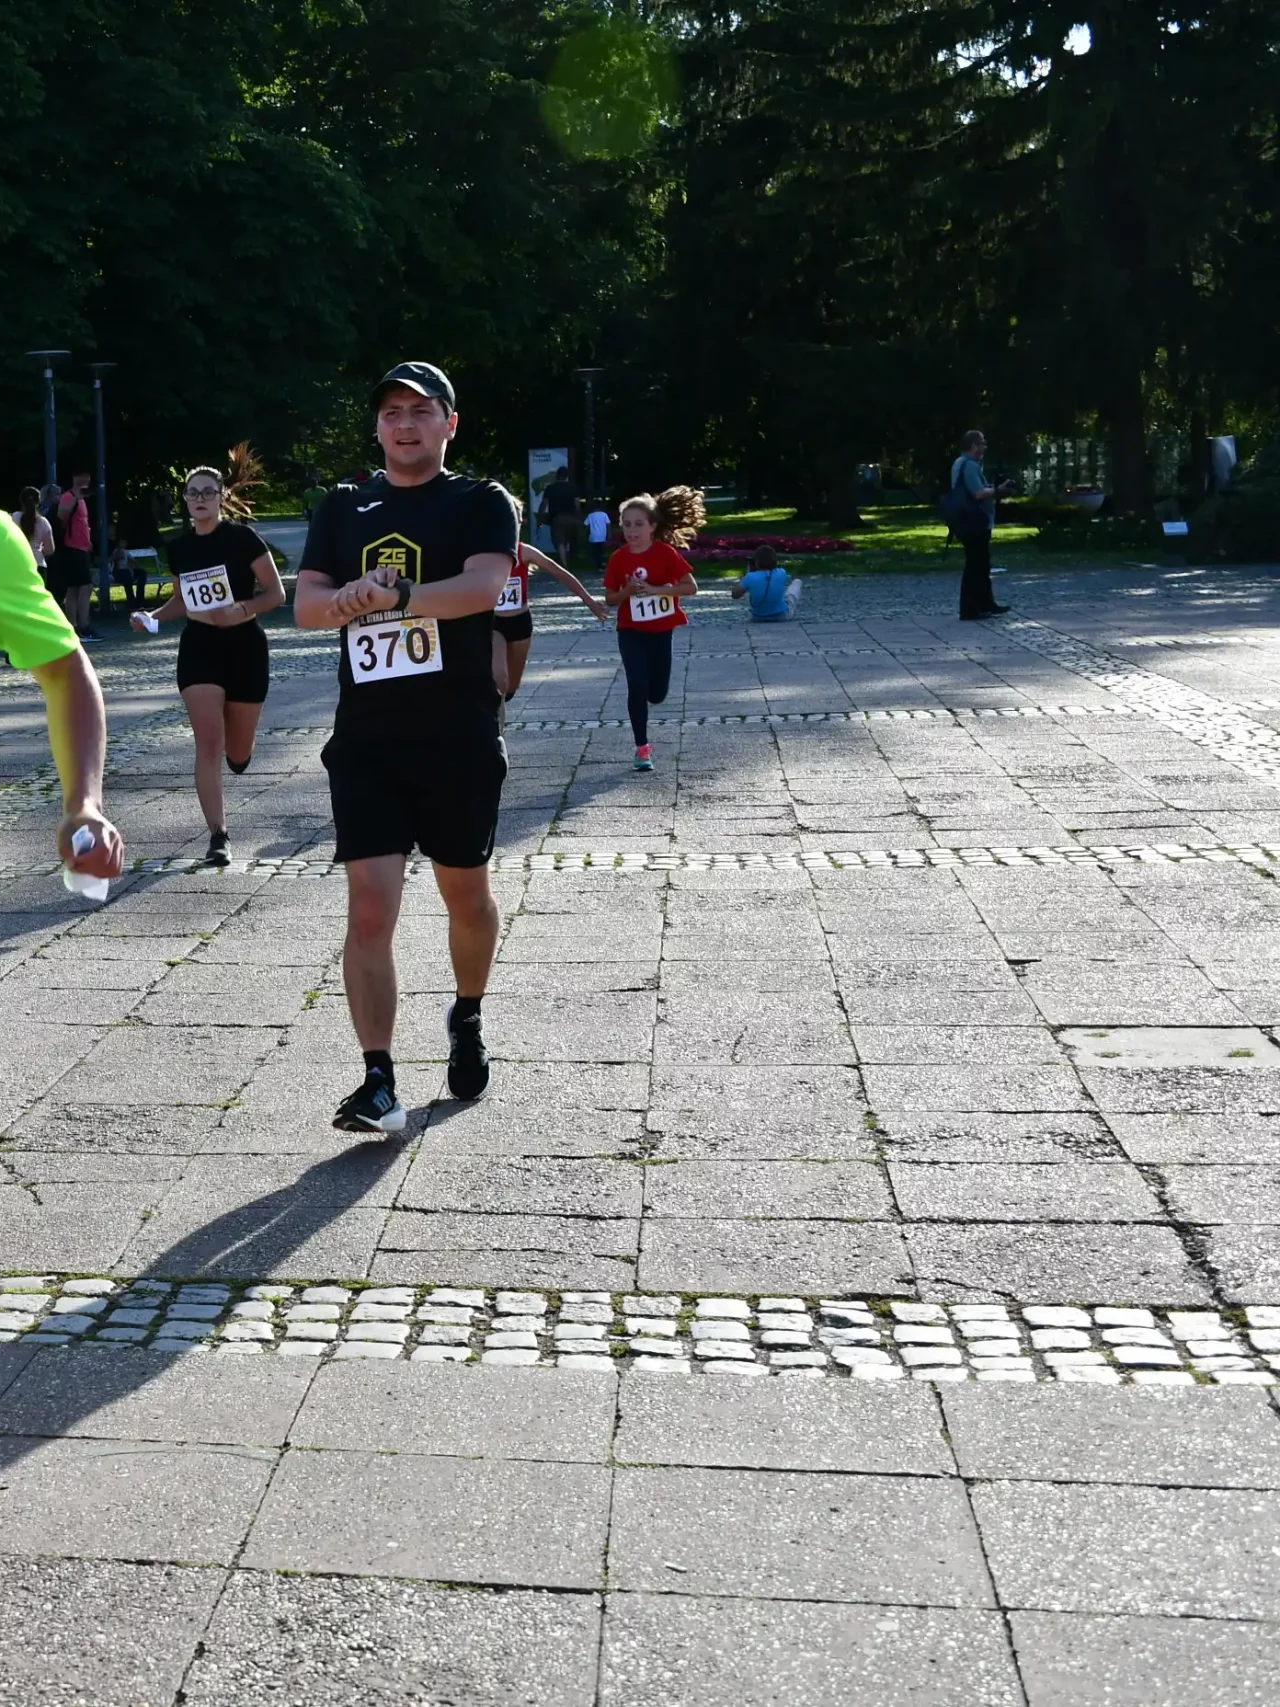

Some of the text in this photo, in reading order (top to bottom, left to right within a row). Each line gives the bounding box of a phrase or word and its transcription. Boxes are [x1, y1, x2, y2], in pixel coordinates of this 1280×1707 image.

[378, 548, 406, 563] ZG
[187, 582, 227, 606] 189
[636, 597, 669, 617] 110
[356, 627, 430, 672] 370
